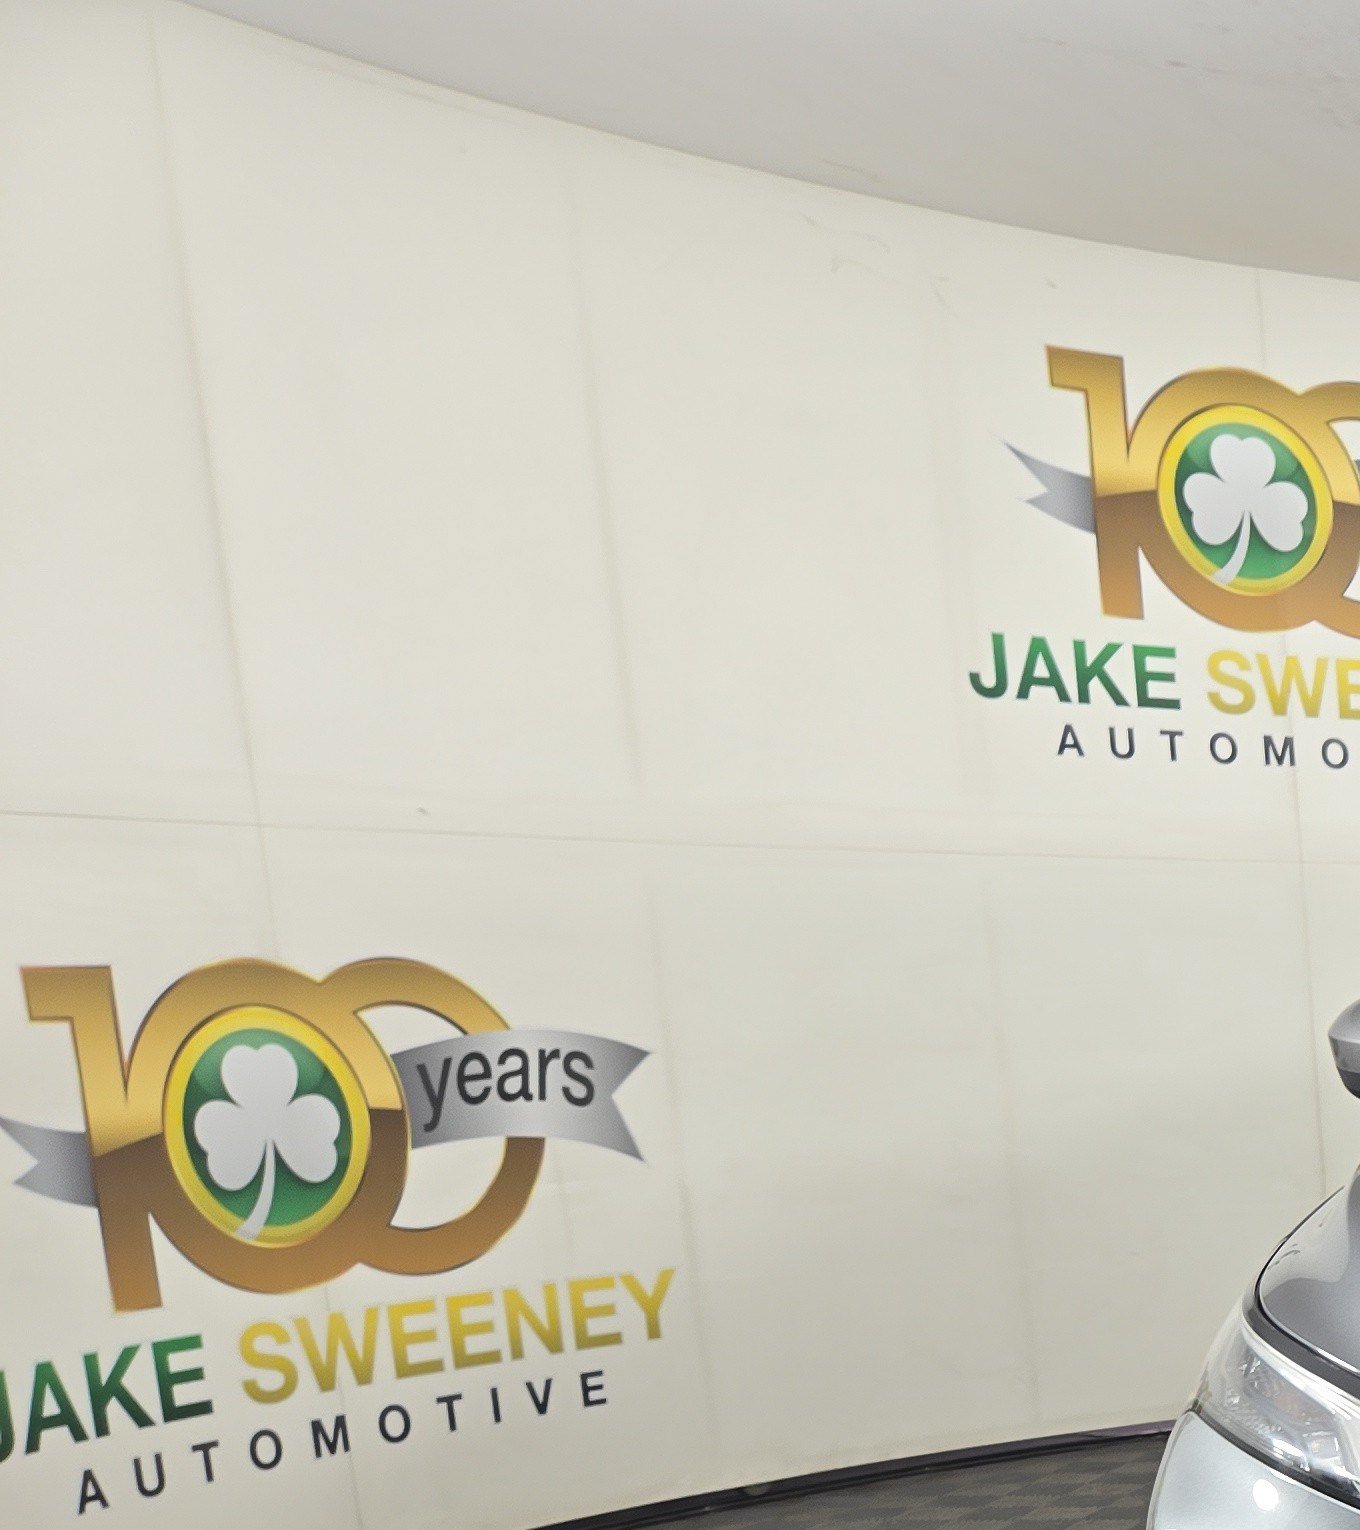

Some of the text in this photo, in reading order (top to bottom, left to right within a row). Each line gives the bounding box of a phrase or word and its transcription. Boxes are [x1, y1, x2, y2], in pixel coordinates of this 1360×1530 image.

[968, 631, 1181, 710] JAKE
[20, 957, 596, 1313] 100 years
[238, 1269, 675, 1404] SWEENEY
[77, 1370, 608, 1514] AUTOMOTIVE
